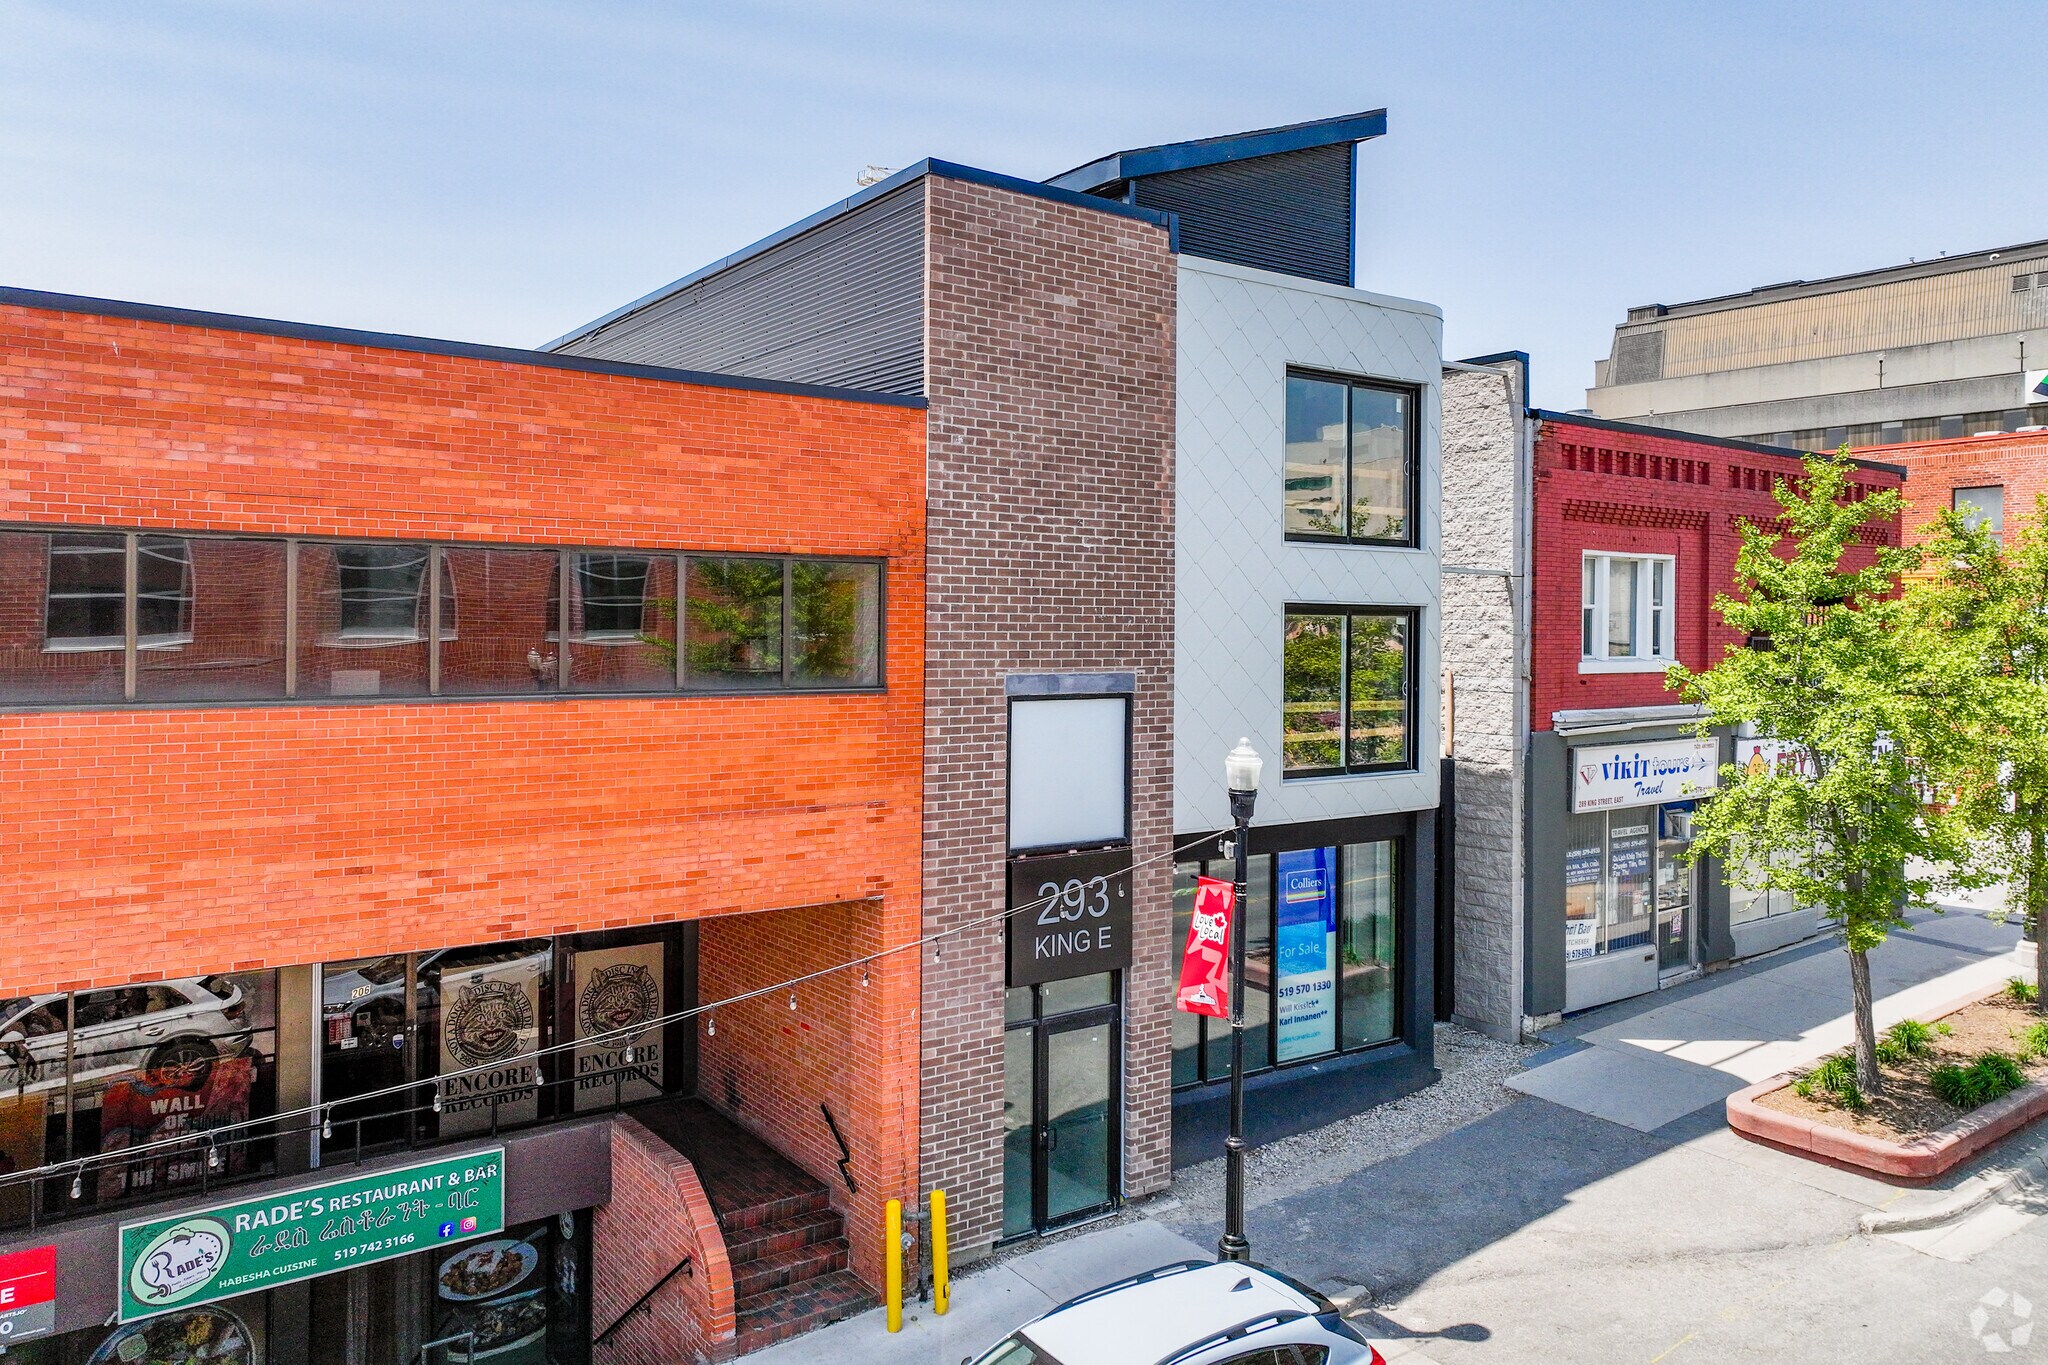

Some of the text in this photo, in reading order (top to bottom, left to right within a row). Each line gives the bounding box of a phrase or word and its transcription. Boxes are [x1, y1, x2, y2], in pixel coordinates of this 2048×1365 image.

[1653, 757, 1690, 776] tours
[1634, 780, 1664, 797] Travel
[1578, 800, 1587, 808] 289
[1588, 799, 1597, 807] KING
[1613, 826, 1647, 836] TRAVEL AGENCY
[1291, 877, 1322, 889] Colliers
[1037, 876, 1110, 926] 293
[1195, 912, 1214, 928] Love
[1035, 926, 1112, 960] KING E
[1200, 927, 1224, 944] Local
[1280, 941, 1320, 958] For Sale
[604, 966, 625, 978] DISC
[352, 986, 370, 998] 206
[1279, 980, 1331, 997] 519 570 1330
[447, 1004, 462, 1026] DOG
[473, 982, 497, 996] DISC
[1280, 1003, 1293, 1013] Will
[1279, 1016, 1293, 1026] Karl
[579, 1044, 659, 1074] ENCORE
[445, 1065, 533, 1097] ENCORE
[579, 1062, 659, 1091] RECORDS
[150, 1094, 205, 1115] WALL
[445, 1089, 534, 1114] RECORDS
[164, 1113, 189, 1130] OF
[235, 1164, 497, 1233] RADE'S RESTAURANT & BAR
[334, 1232, 415, 1261] 519 742 3166
[150, 1251, 214, 1278] RADE'S
[219, 1269, 271, 1288] HABESHA
[272, 1258, 318, 1275] CUISINE
[0, 1287, 15, 1304] E
